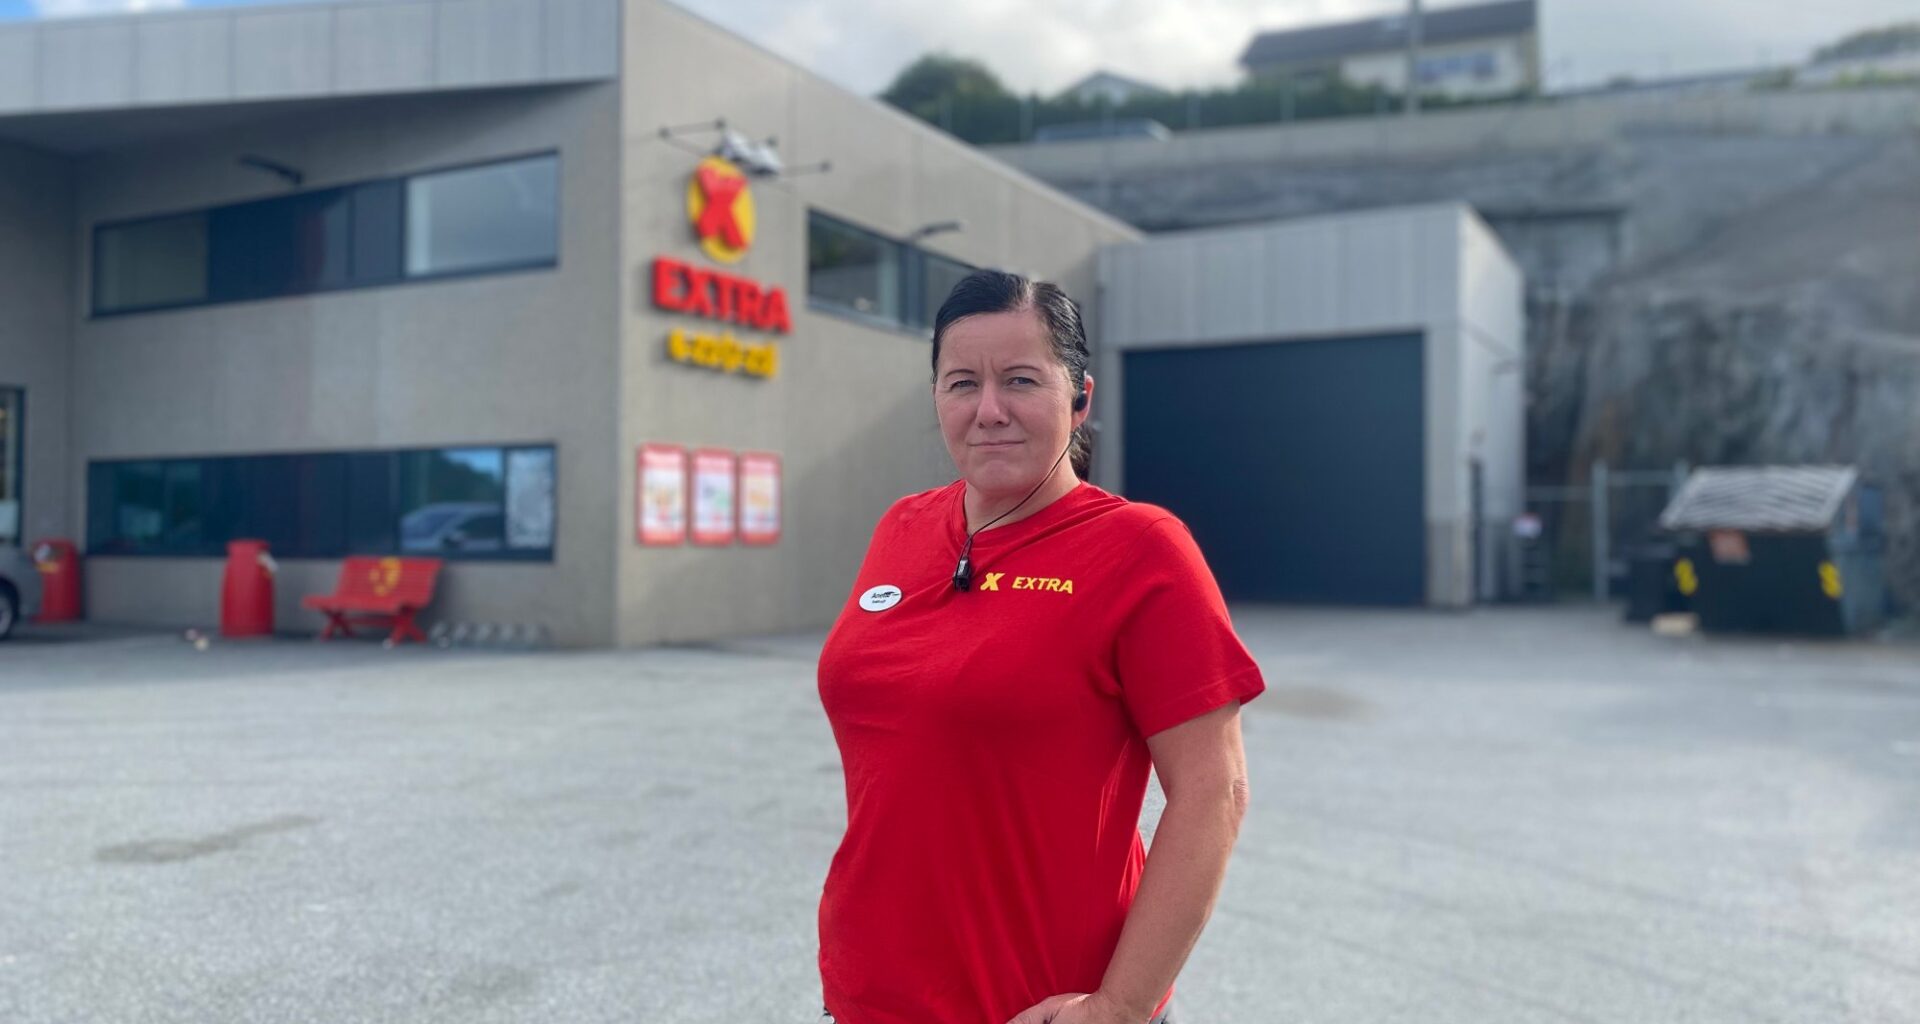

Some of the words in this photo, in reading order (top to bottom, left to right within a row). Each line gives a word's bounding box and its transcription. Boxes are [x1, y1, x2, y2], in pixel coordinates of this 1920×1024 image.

[653, 256, 793, 334] EXTRA
[980, 572, 1005, 591] X
[1011, 576, 1073, 594] EXTRA
